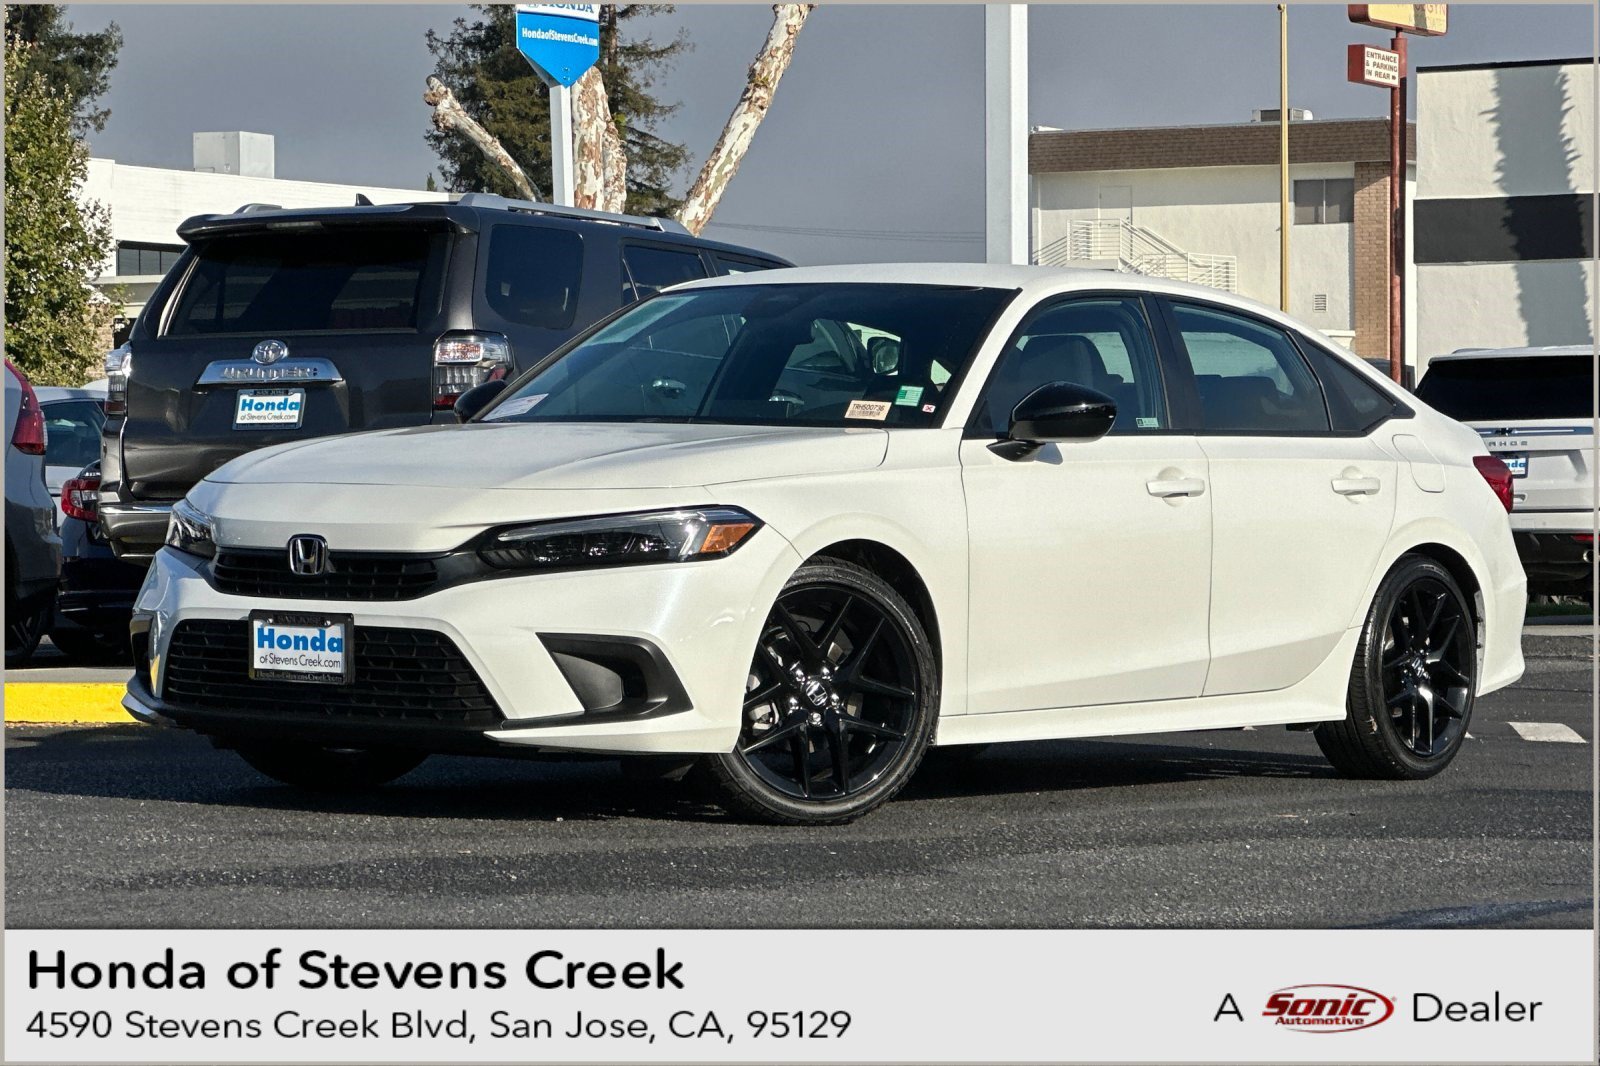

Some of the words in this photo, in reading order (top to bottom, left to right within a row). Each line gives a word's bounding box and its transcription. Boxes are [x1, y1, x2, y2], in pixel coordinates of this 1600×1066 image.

[1366, 51, 1397, 63] ENTRANCE
[1373, 61, 1398, 72] PARKING
[1375, 70, 1391, 79] REAR
[241, 398, 300, 411] Honda
[247, 413, 267, 421] Stevens
[267, 413, 296, 421] Creek.com
[257, 627, 343, 653] Honda
[260, 655, 269, 664] of
[269, 653, 298, 666] Stevens
[299, 654, 341, 668] Creek.com
